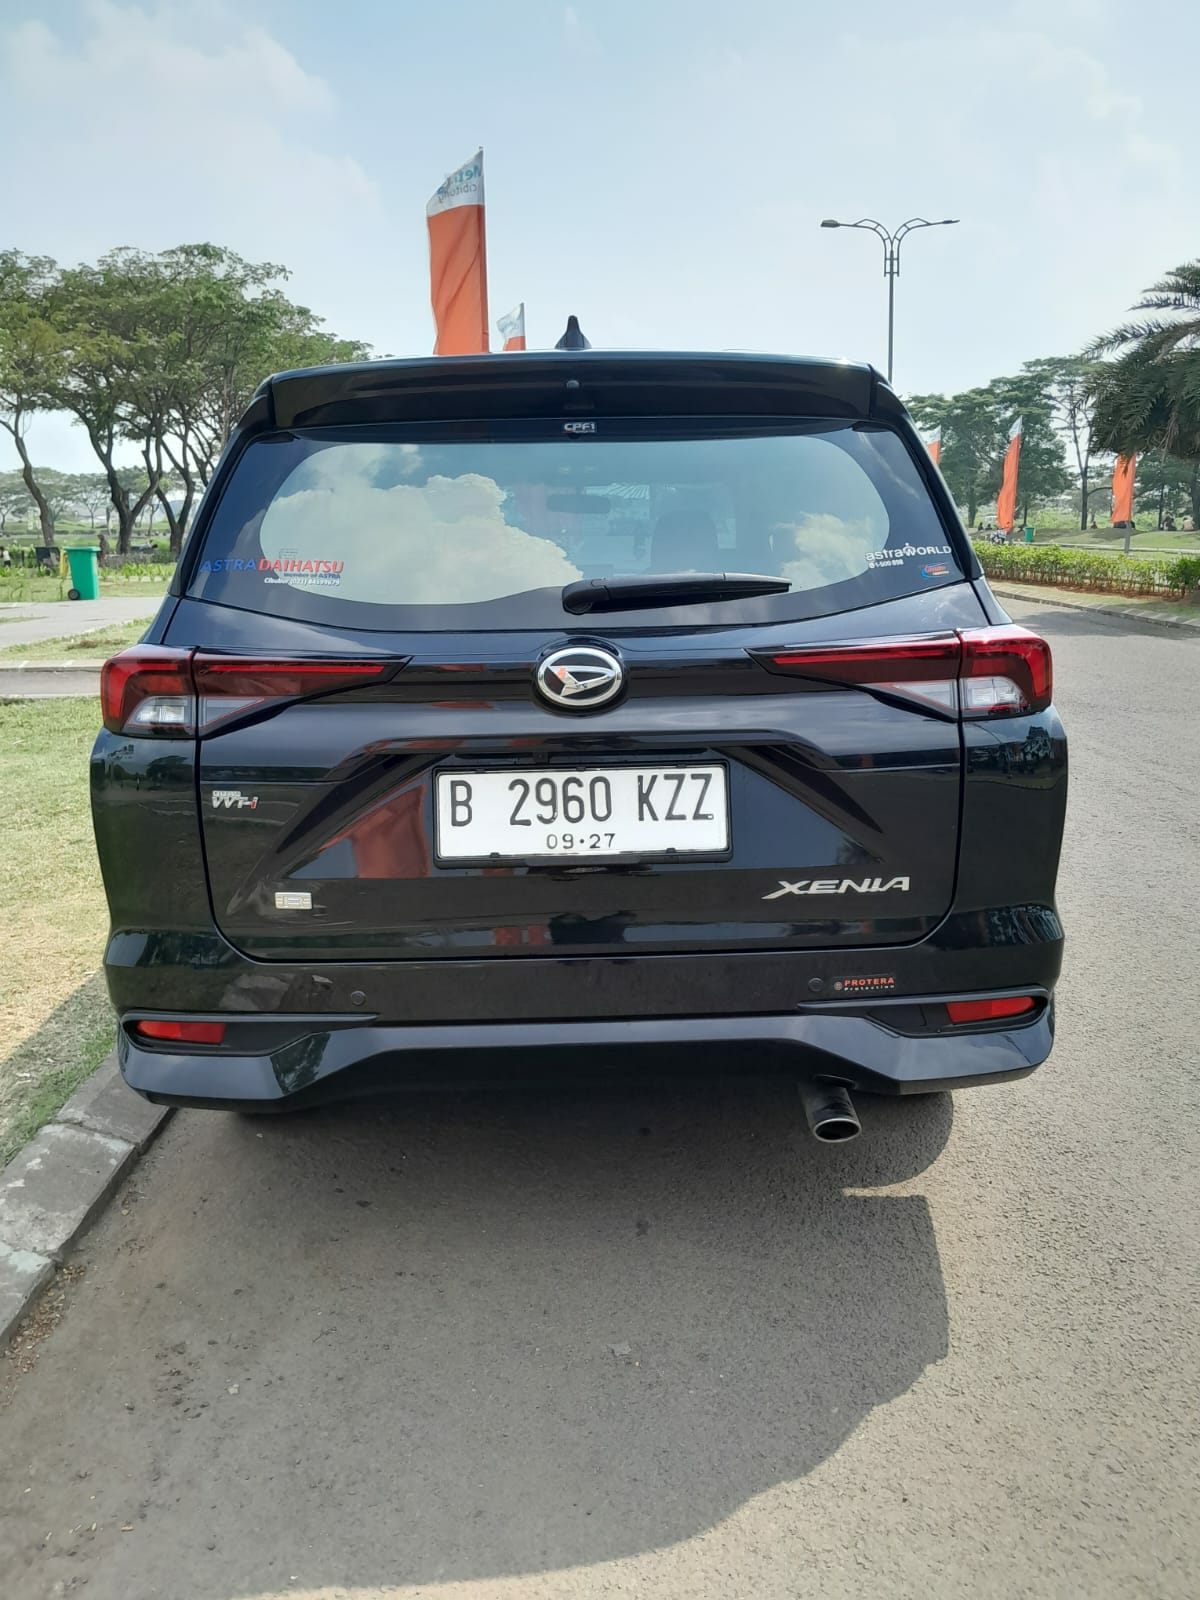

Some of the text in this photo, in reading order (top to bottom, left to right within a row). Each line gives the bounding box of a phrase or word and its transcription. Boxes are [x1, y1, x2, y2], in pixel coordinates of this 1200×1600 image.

[200, 559, 344, 574] ASTRA DAIHATSU
[450, 773, 714, 827] B 2960 KZZ
[761, 876, 910, 900] XENIA
[844, 977, 895, 986] PROTERA
